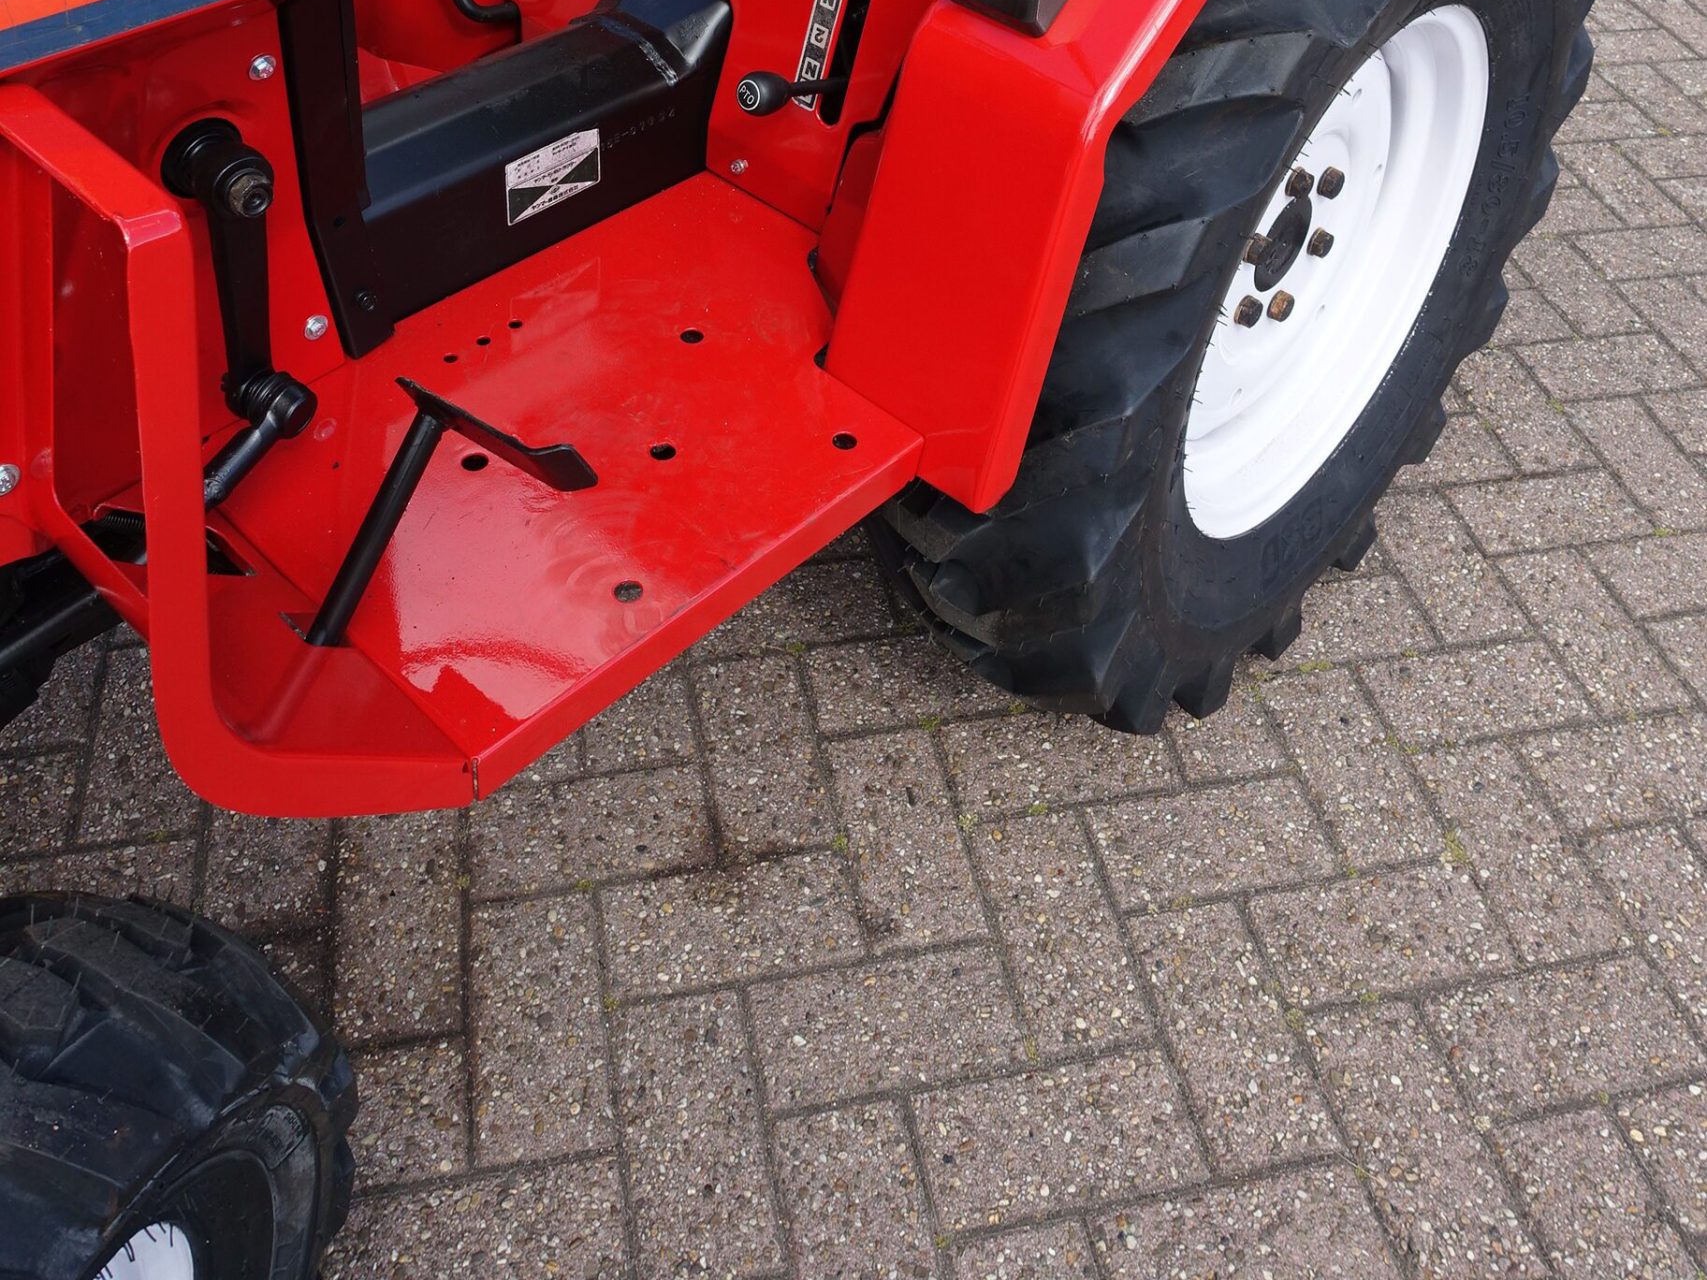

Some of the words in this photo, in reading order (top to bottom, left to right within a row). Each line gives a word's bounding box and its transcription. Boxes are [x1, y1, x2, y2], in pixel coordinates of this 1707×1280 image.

[814, 27, 824, 43] 2
[805, 60, 819, 78] N
[738, 84, 756, 105] PTO
